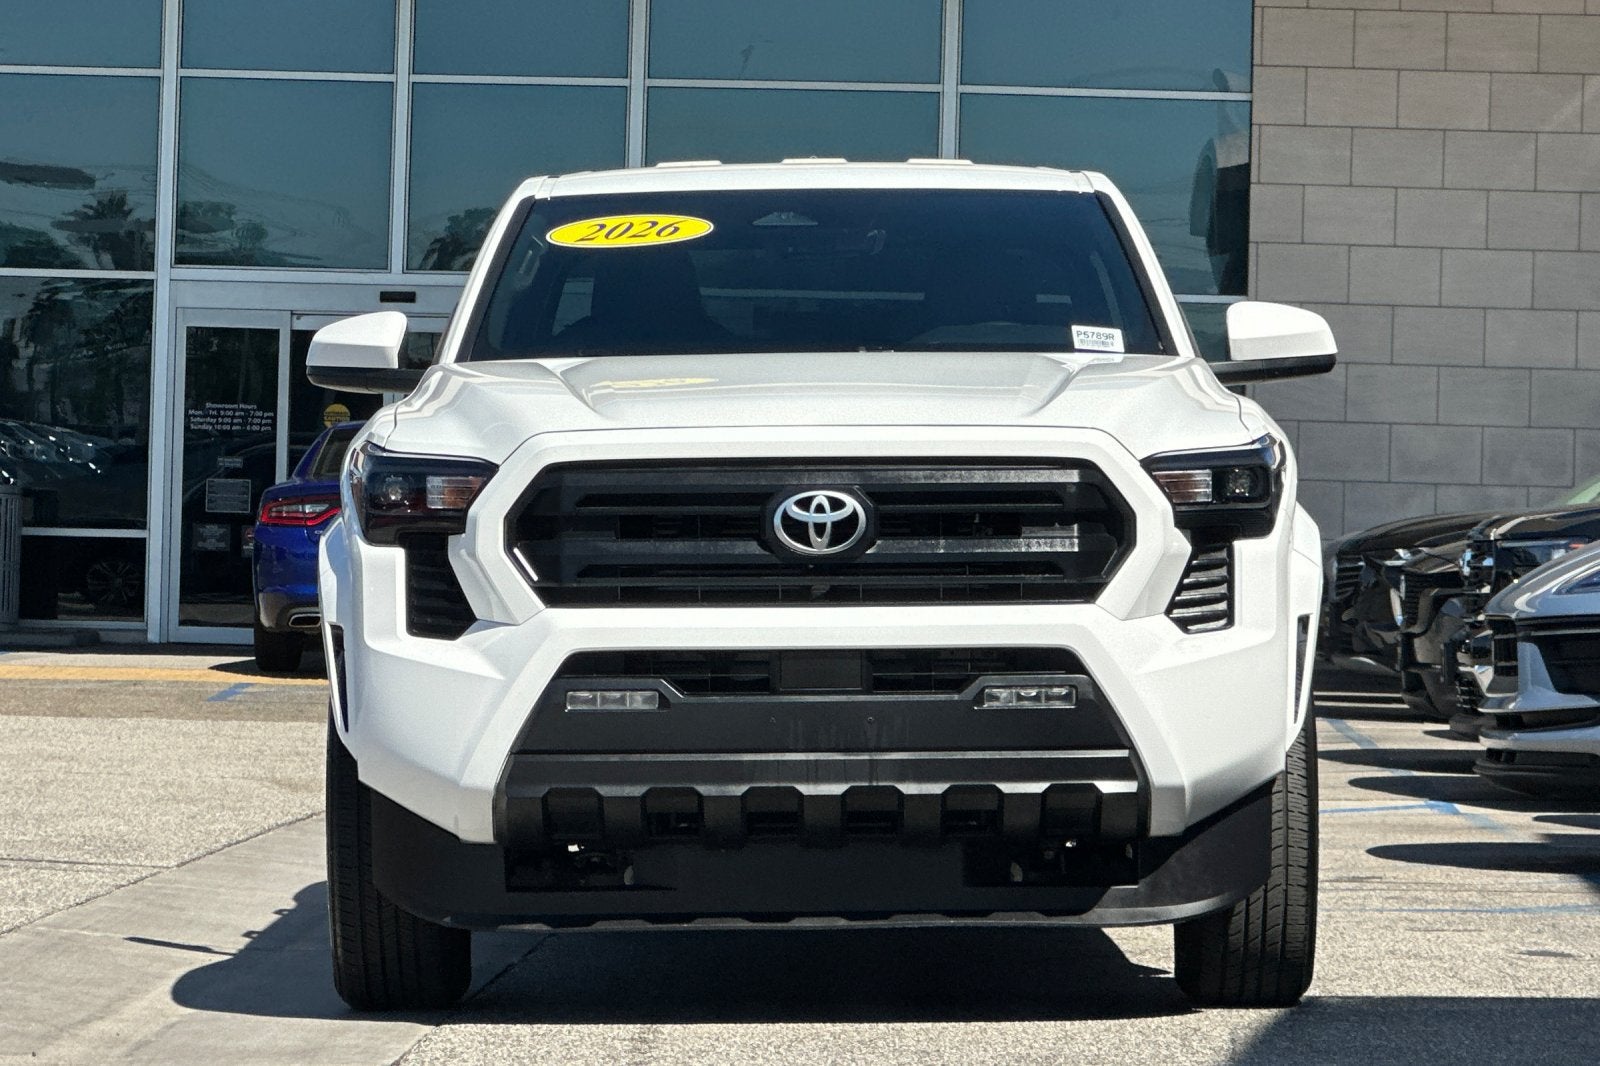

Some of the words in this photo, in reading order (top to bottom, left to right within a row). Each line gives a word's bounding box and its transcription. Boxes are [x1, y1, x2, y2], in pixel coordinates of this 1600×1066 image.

[574, 219, 688, 243] 2026
[1076, 330, 1115, 341] P5789R
[190, 416, 216, 424] Saturday
[190, 423, 212, 431] Sunday
